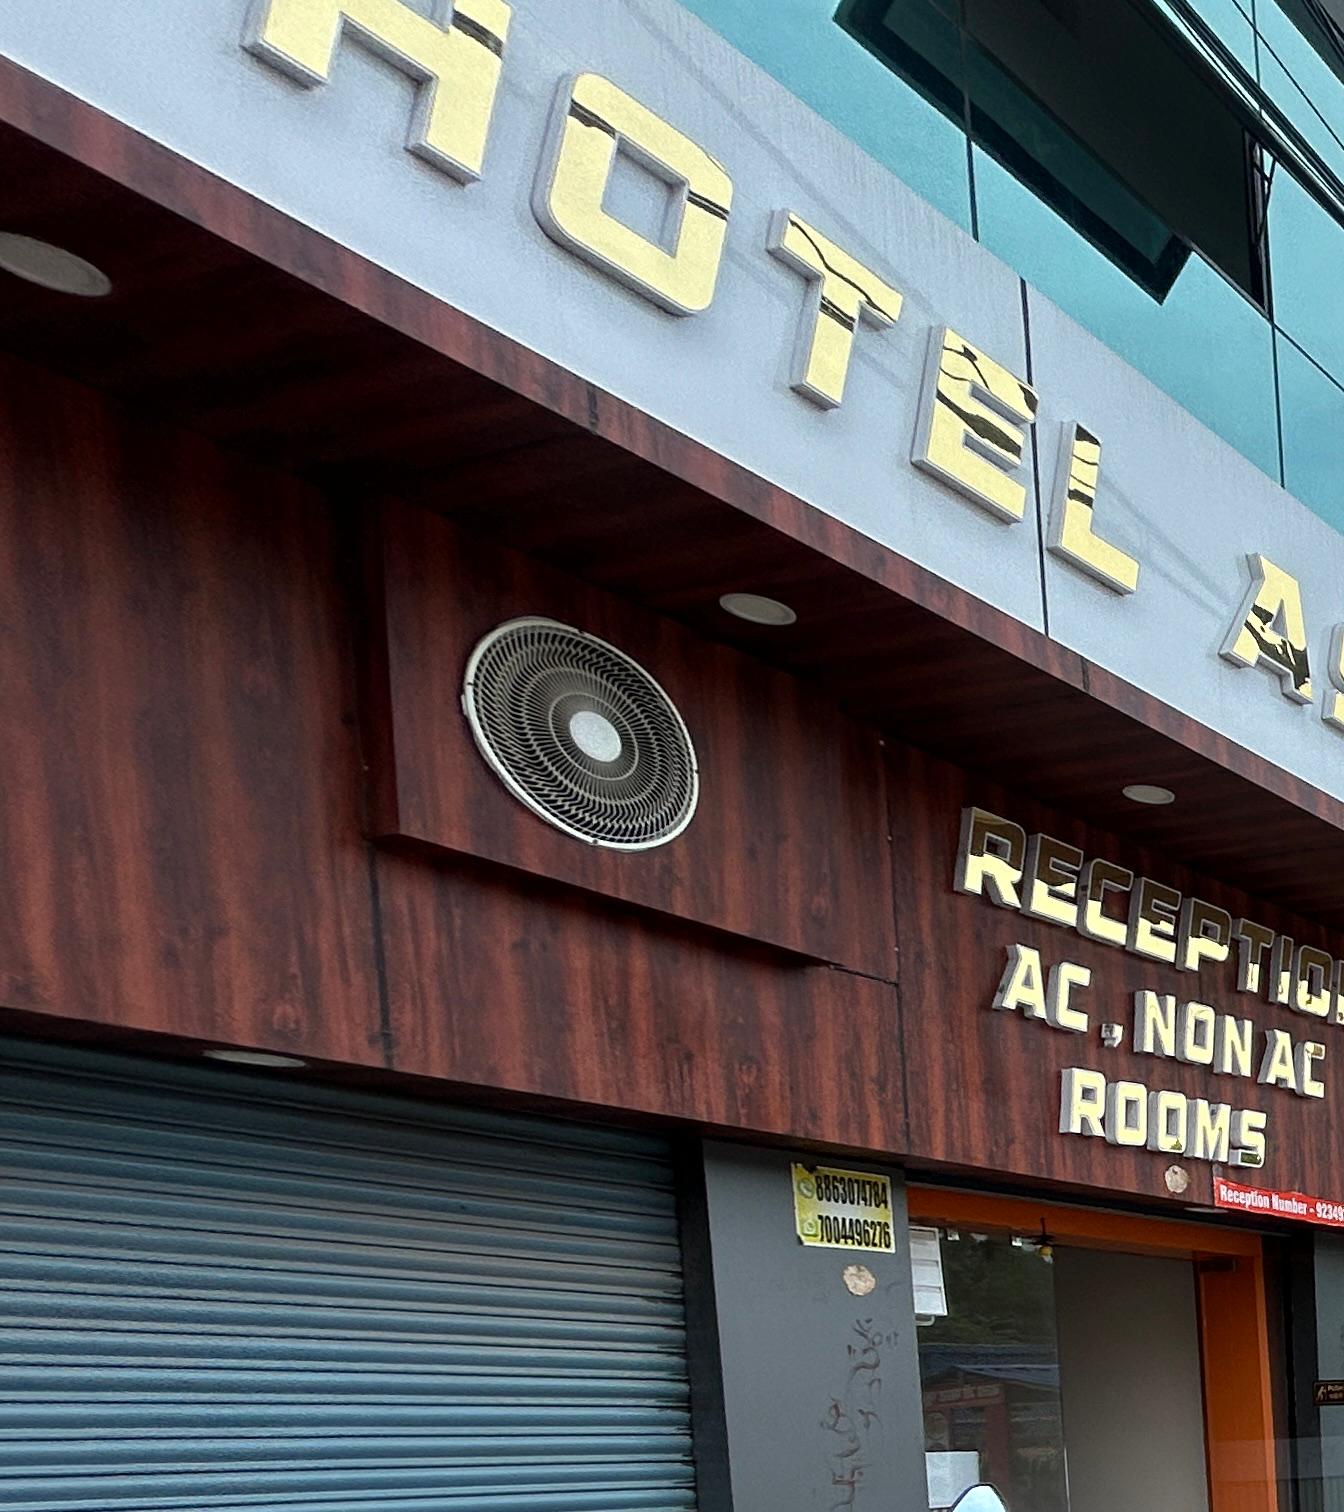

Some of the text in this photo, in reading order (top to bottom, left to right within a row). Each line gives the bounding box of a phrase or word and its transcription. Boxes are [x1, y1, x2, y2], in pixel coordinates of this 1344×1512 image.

[243, 0, 1140, 596] HOTEL
[1059, 1066, 1268, 1168] ROOMS
[815, 1175, 888, 1210] 8863074784
[1219, 1184, 1270, 1208] Reception
[1271, 1194, 1308, 1215] Number
[816, 1214, 892, 1249] 7004496276
